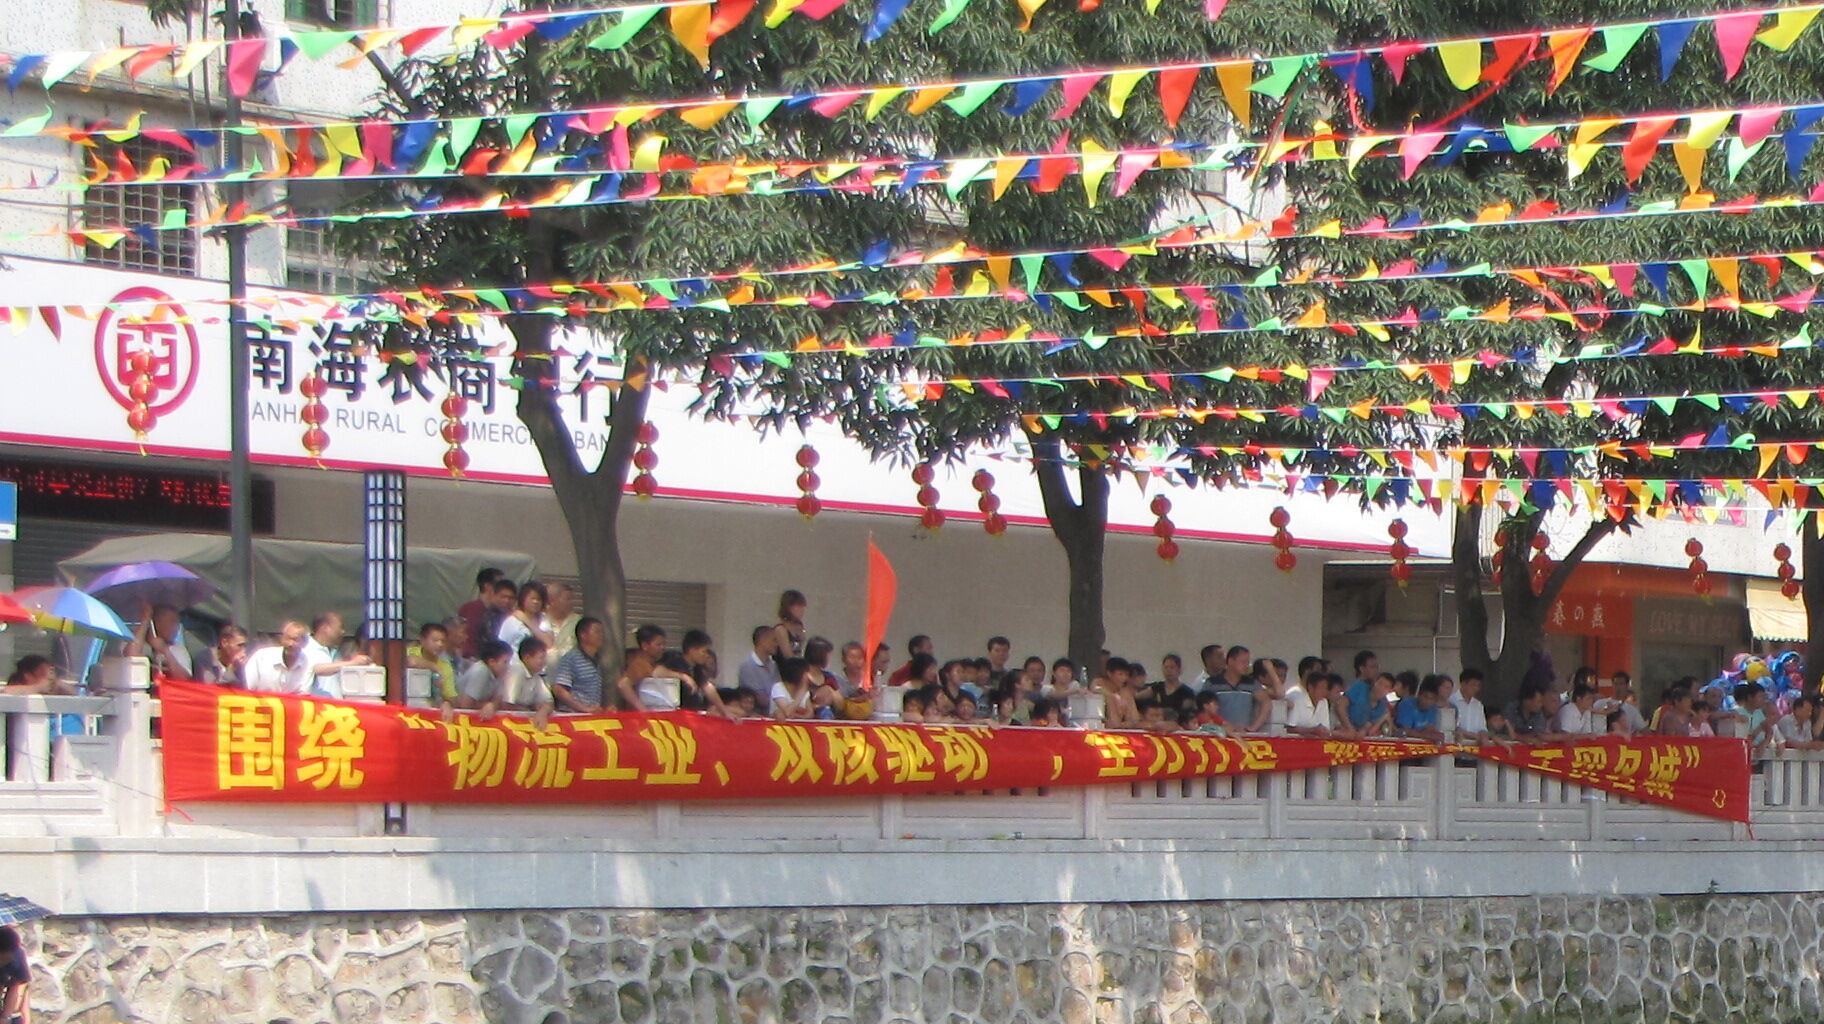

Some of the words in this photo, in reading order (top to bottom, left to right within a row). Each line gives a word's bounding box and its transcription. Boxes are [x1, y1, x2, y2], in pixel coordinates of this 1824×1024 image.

[246, 314, 626, 424] 南海农商行
[336, 408, 407, 433] RURAL
[575, 430, 609, 452] BAN
